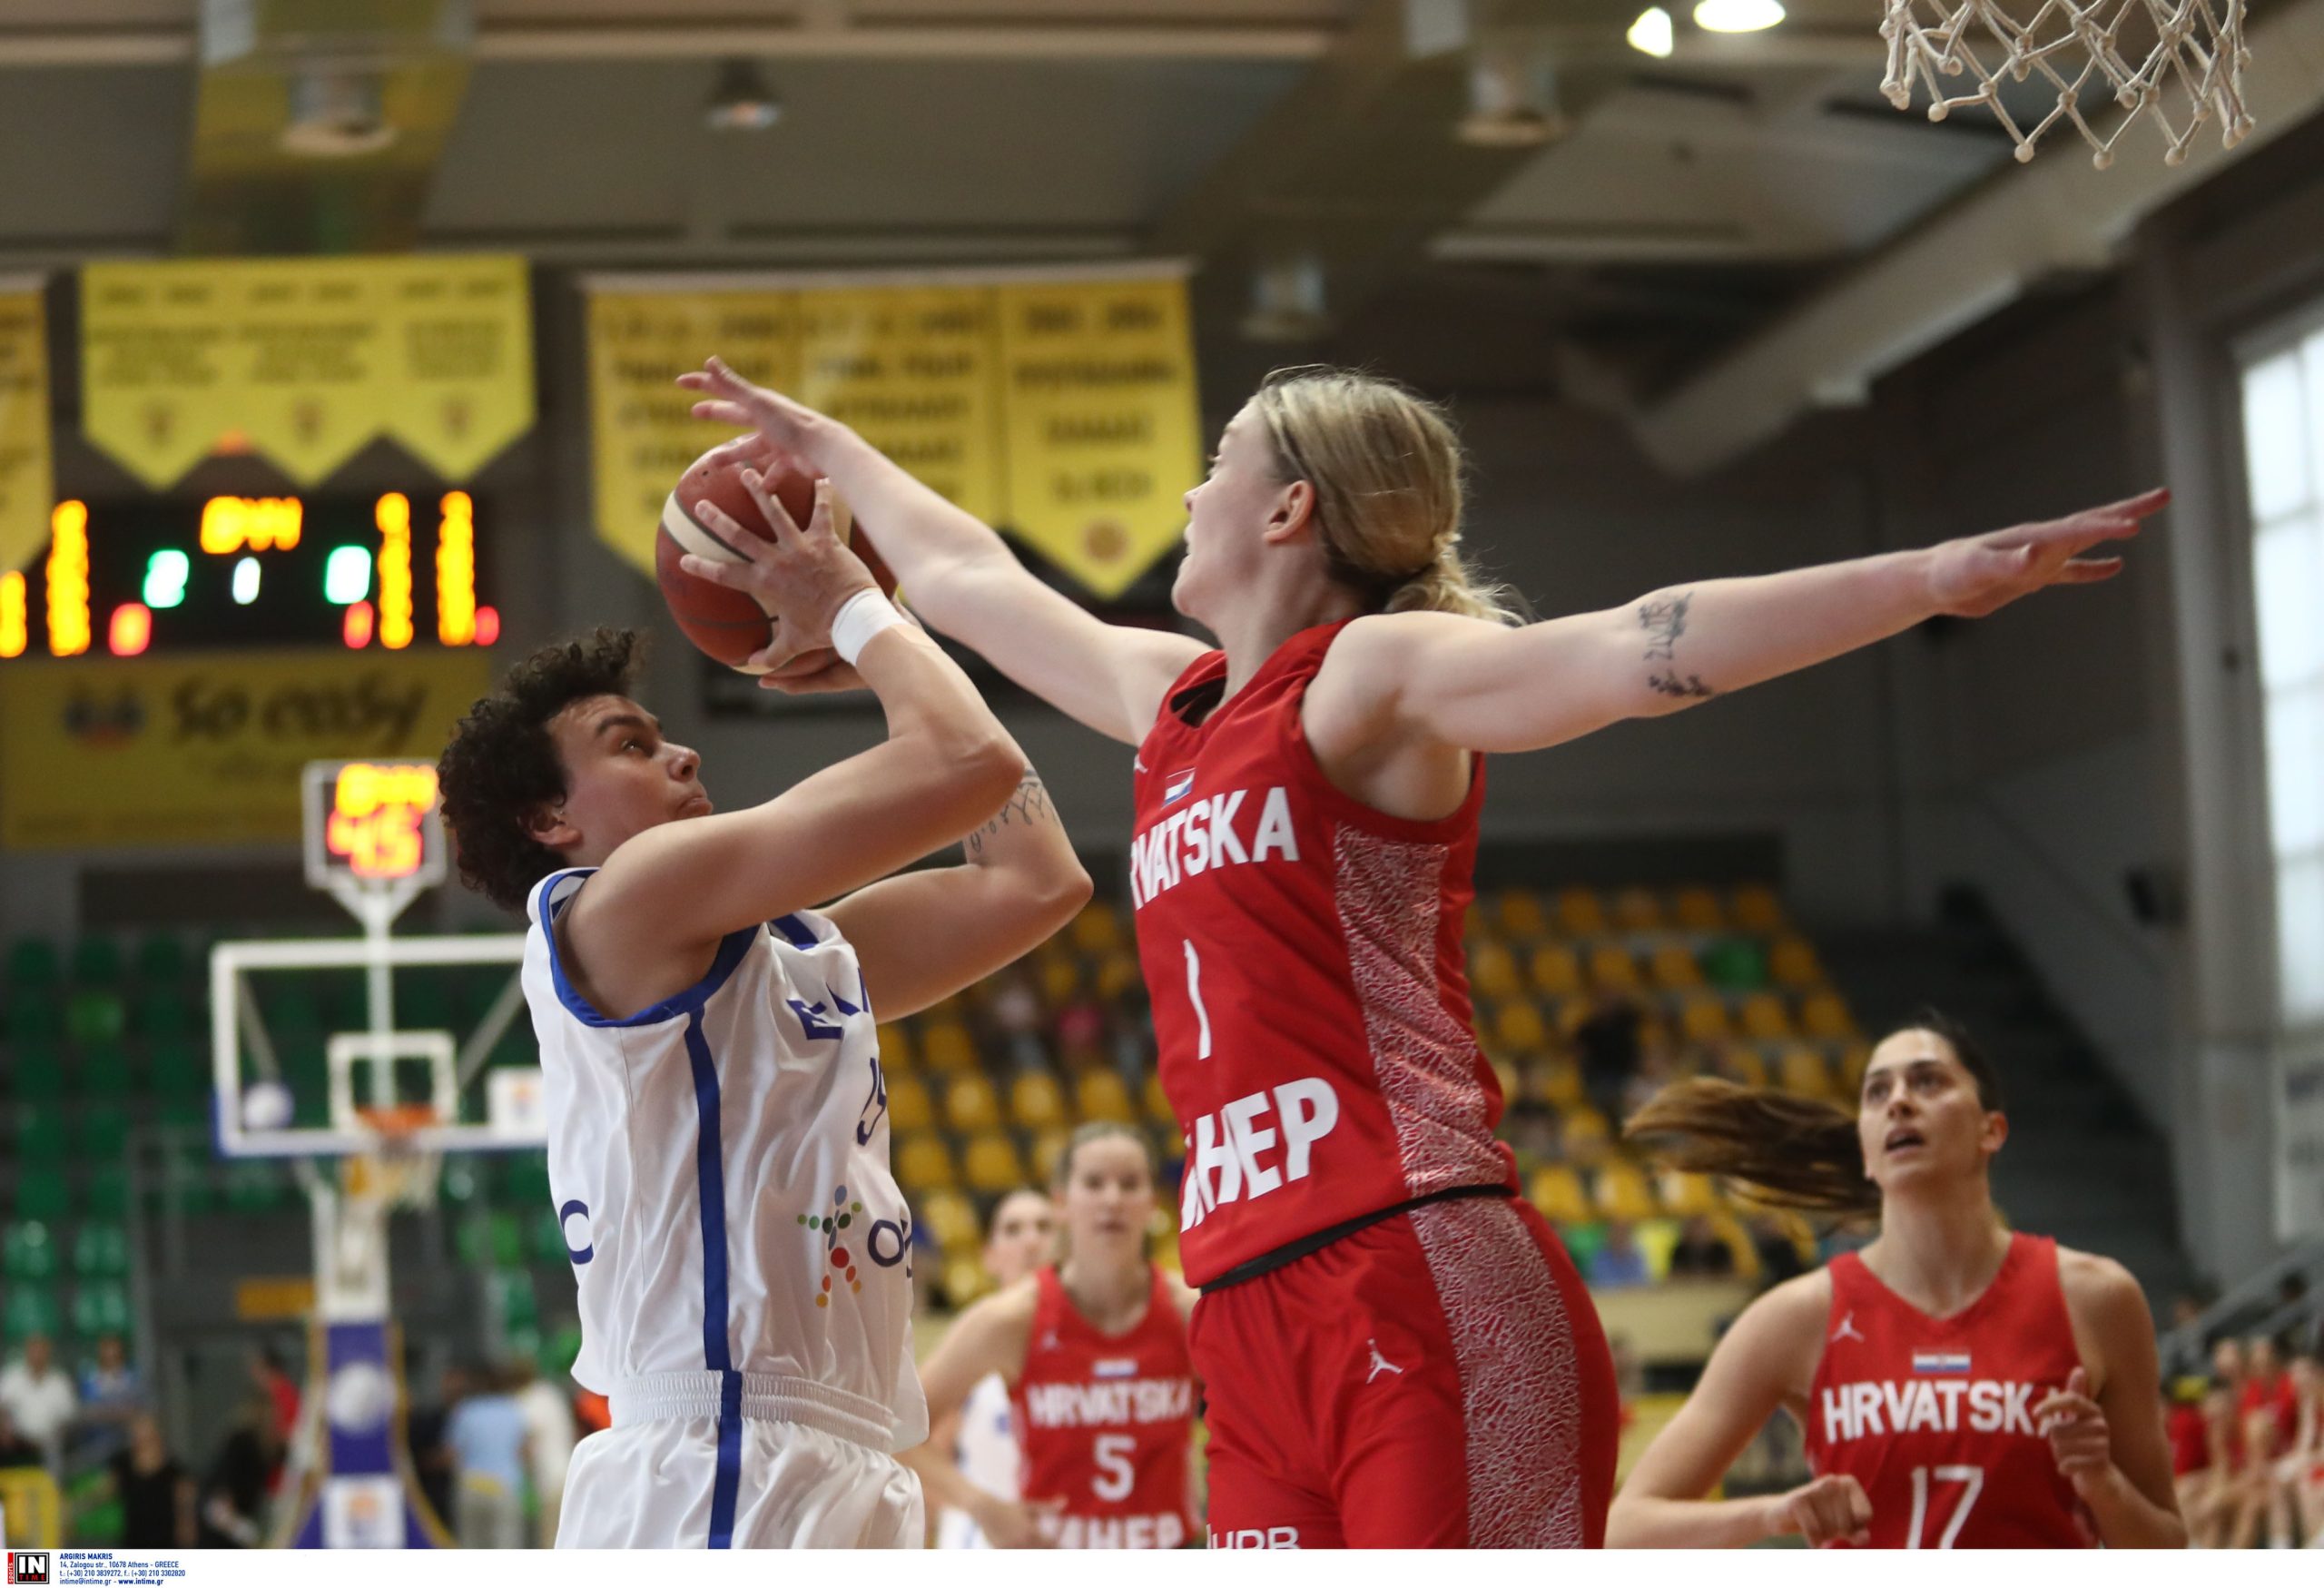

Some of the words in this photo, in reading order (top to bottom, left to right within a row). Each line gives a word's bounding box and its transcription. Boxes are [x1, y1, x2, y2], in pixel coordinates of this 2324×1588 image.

[1184, 939, 1212, 1060] 1
[1093, 1434, 1135, 1502] 5
[1905, 1465, 1984, 1549] 17
